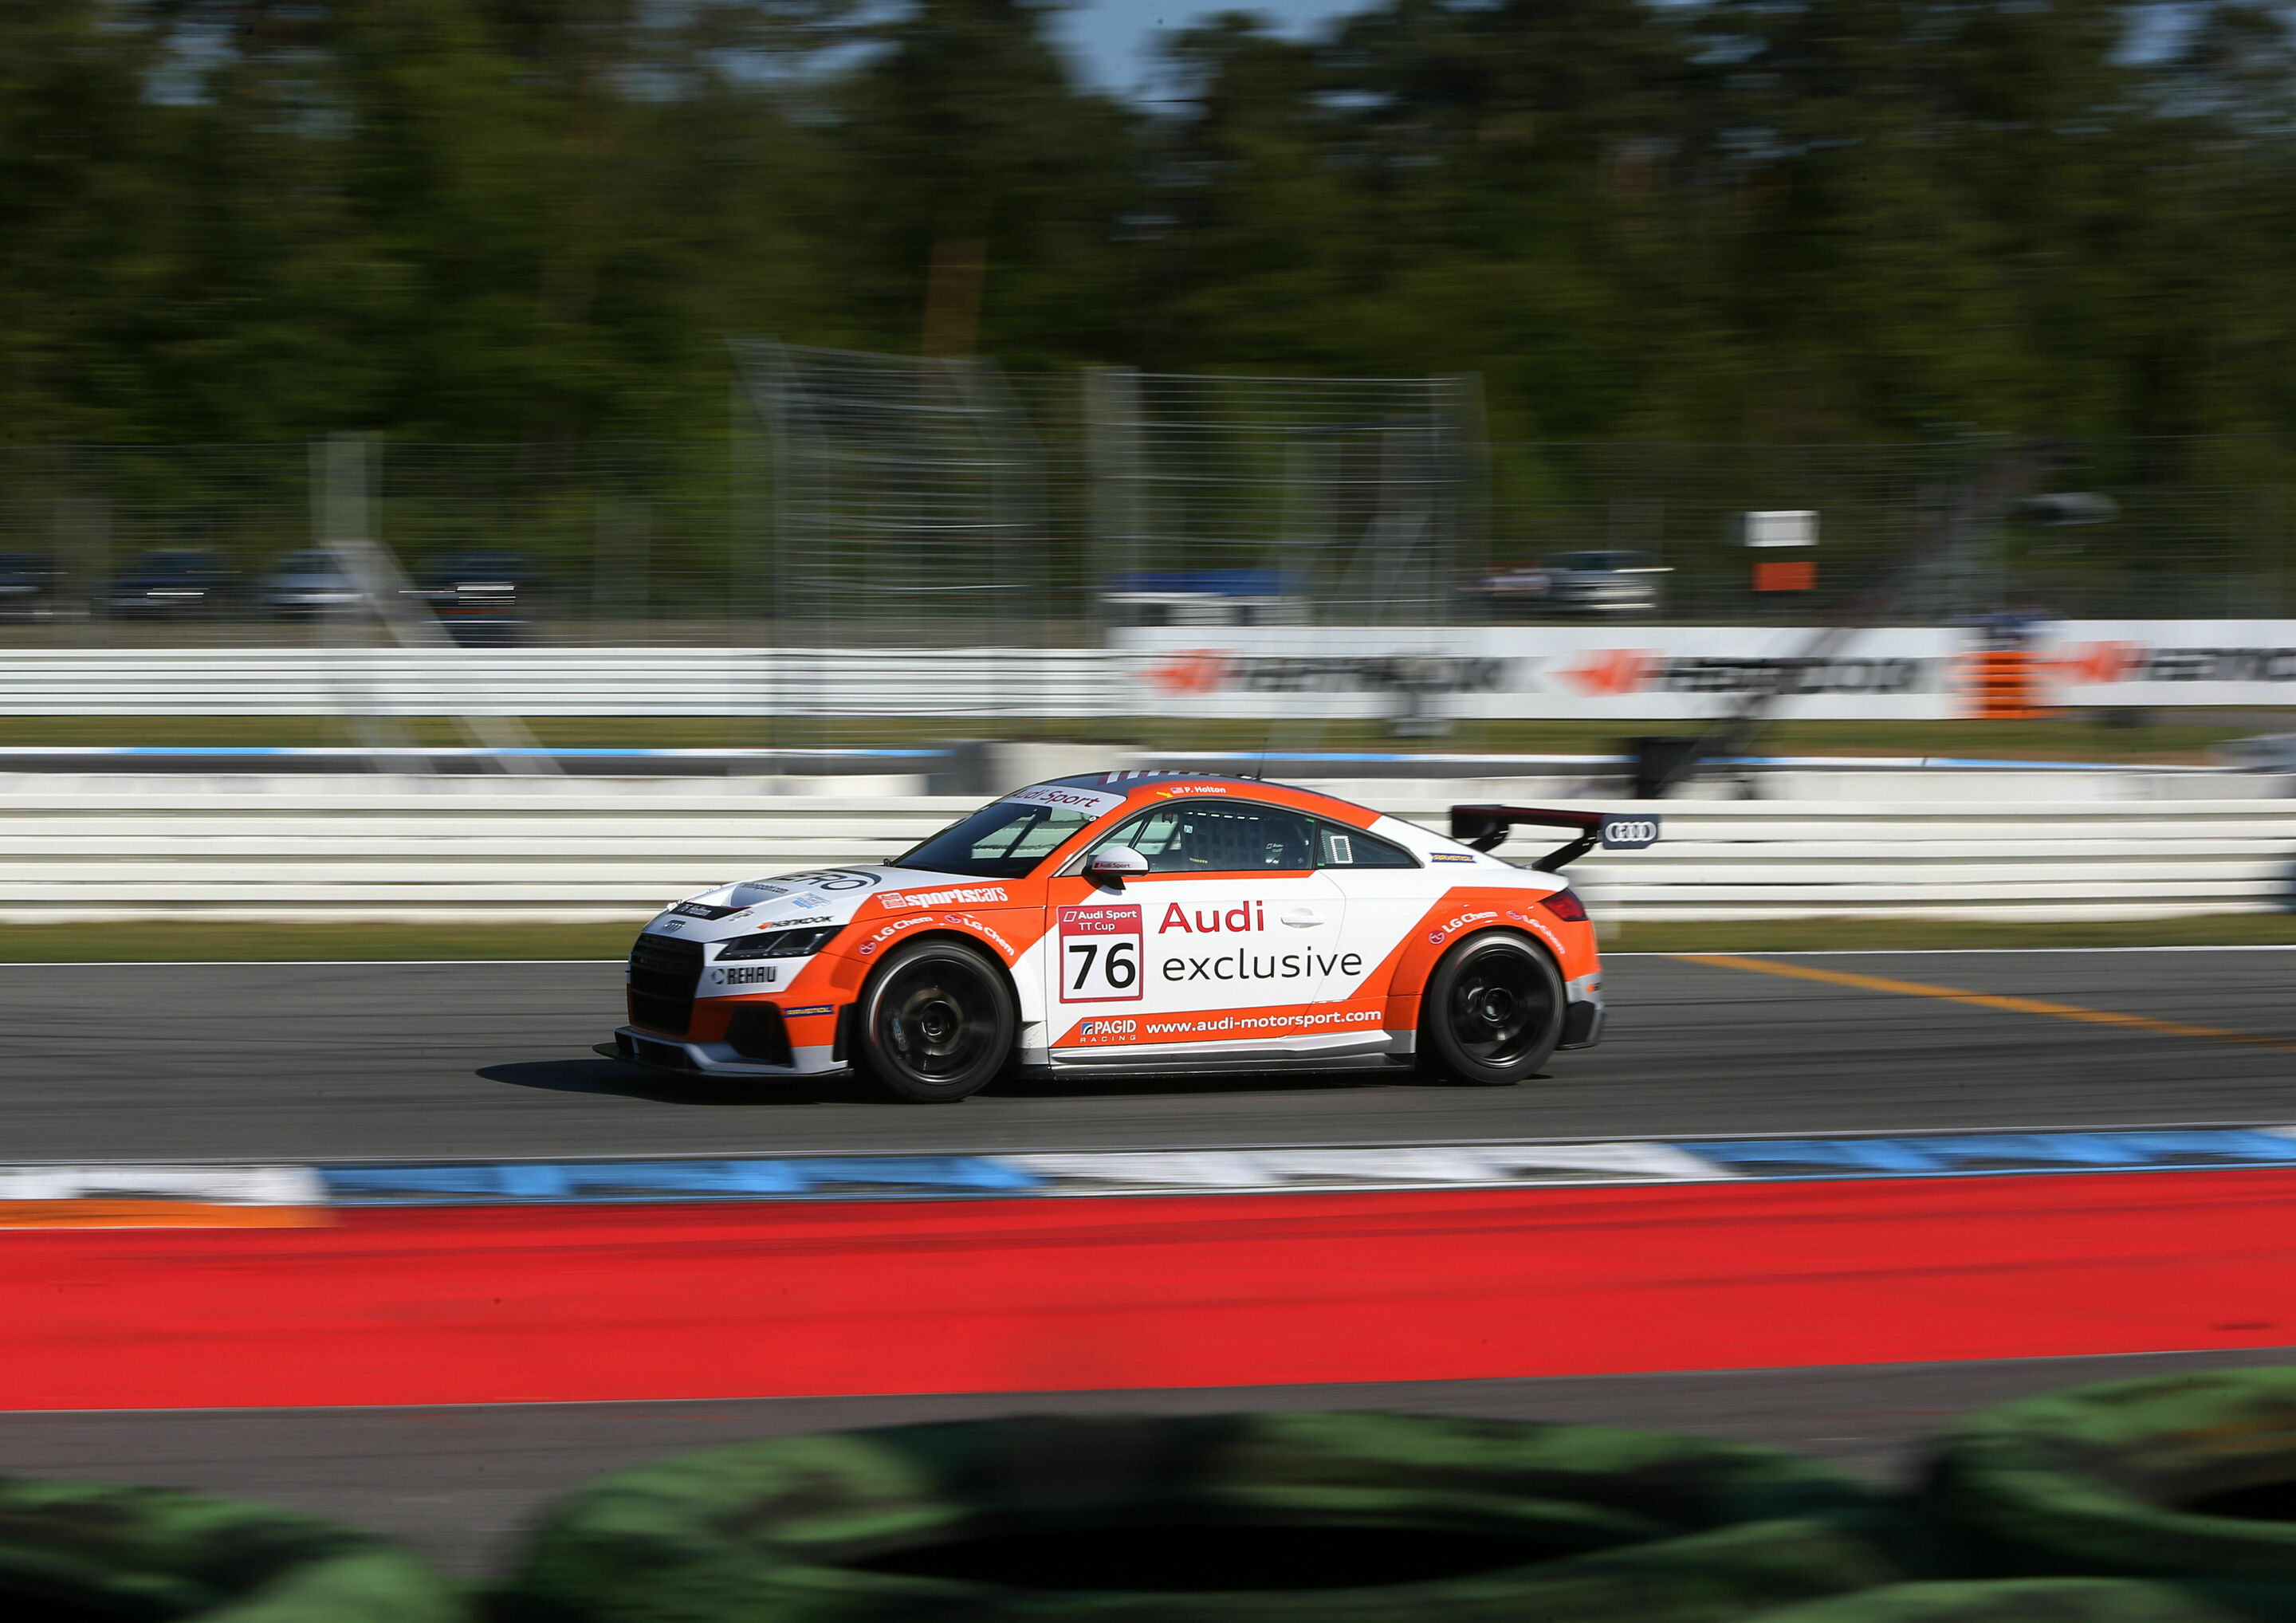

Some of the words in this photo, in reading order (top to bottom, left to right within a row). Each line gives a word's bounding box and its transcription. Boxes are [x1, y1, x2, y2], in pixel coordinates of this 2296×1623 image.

[1040, 790, 1100, 808] Sport
[904, 886, 1008, 908] sportscars
[1078, 910, 1103, 920] Audi
[1106, 910, 1137, 921] Sport
[1095, 922, 1115, 931] Cup
[1158, 901, 1264, 933] Audi
[1441, 918, 1464, 933] LG
[1461, 911, 1499, 923] Chem
[872, 926, 896, 941] LG
[893, 916, 934, 929] Chem
[964, 918, 984, 931] LG
[984, 927, 1015, 956] Chem
[1069, 942, 1136, 989] 76
[1162, 945, 1362, 981] exclusive
[727, 966, 777, 984] REHAU
[1095, 1020, 1137, 1035] PAGID
[1145, 1010, 1382, 1034] www.audi-motorsport.com
